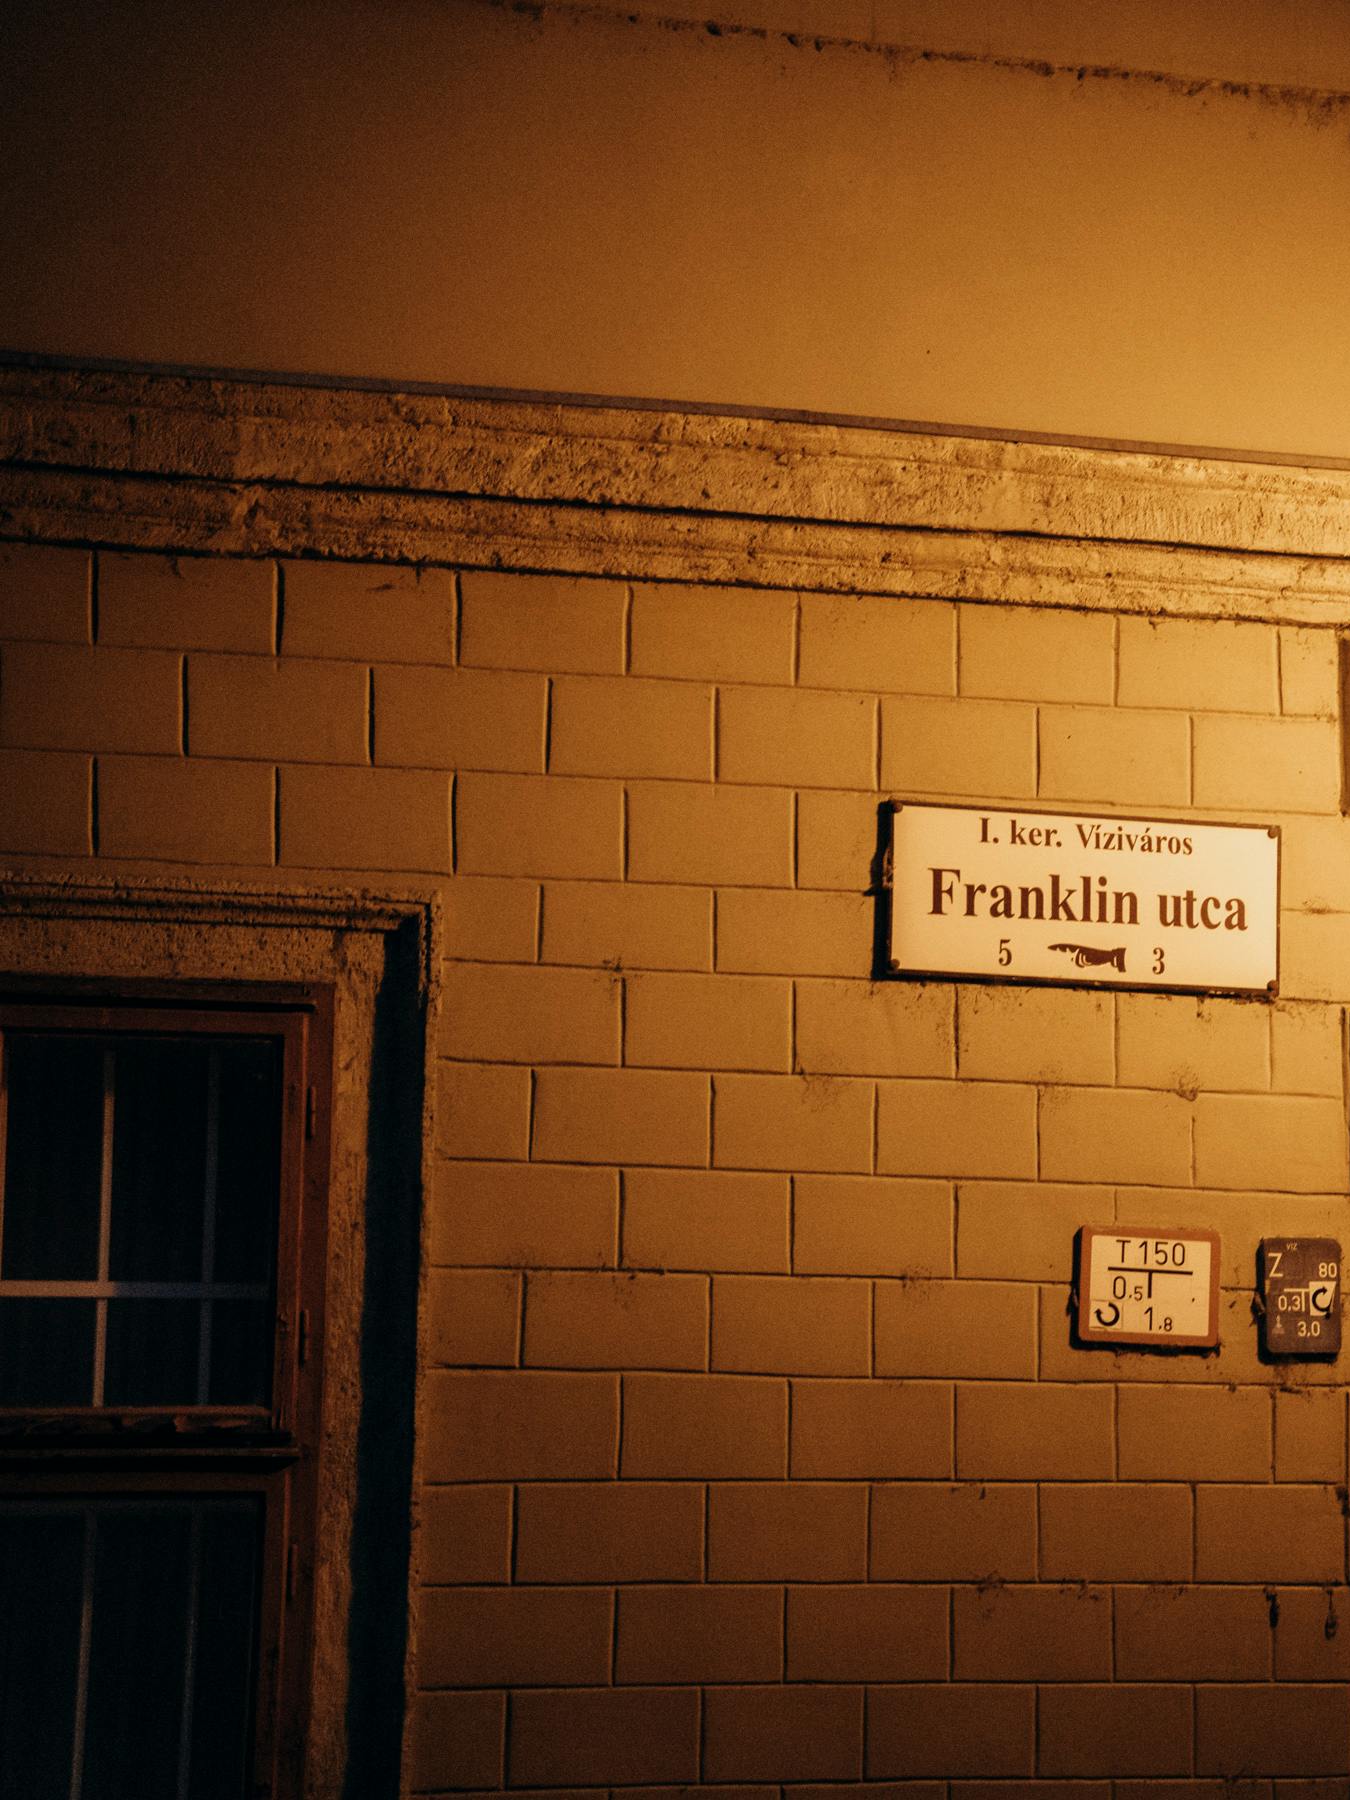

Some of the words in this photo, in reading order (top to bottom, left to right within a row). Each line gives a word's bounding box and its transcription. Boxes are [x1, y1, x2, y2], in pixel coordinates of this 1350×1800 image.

[979, 817, 999, 844] I.
[1010, 820, 1062, 848] ker.
[1075, 823, 1193, 855] Víziváros
[928, 867, 1140, 925] Franklin
[1158, 888, 1248, 931] utca
[998, 939, 1012, 966] 5
[1152, 947, 1165, 975] 3
[1268, 1252, 1284, 1277] Z
[1318, 1262, 1337, 1278] 80
